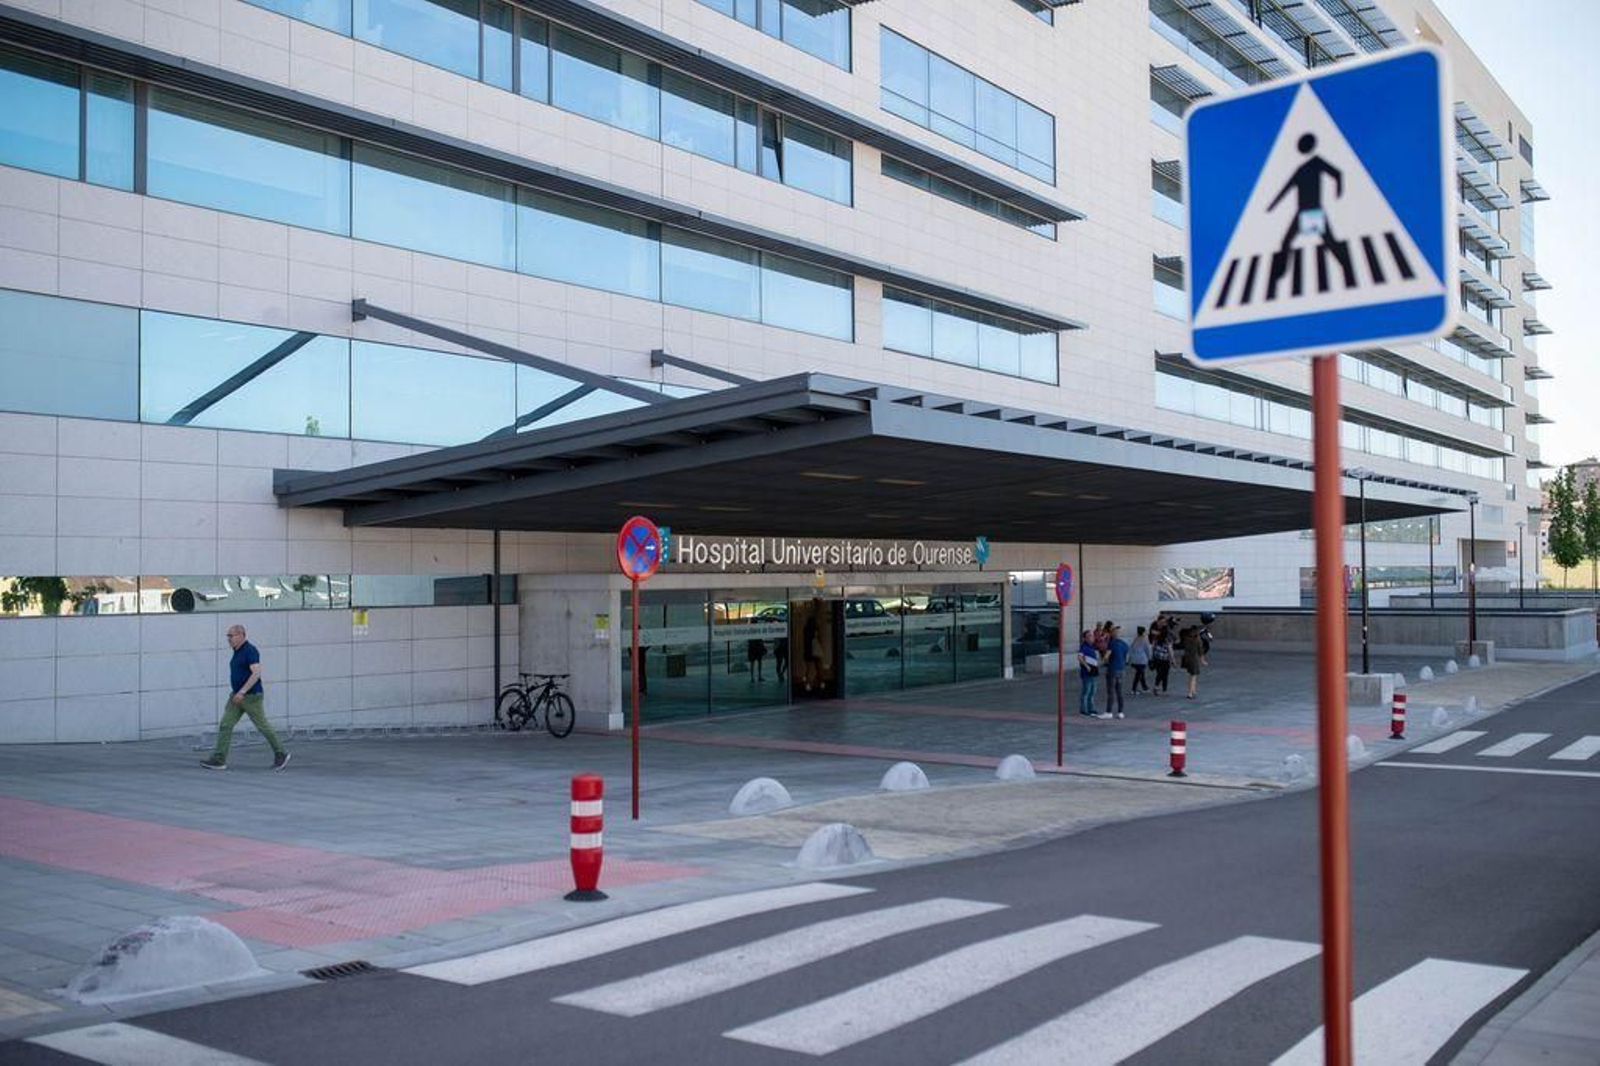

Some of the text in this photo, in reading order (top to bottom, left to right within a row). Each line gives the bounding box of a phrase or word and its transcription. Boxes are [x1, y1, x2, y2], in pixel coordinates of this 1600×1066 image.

[678, 536, 972, 570] Hospital Universitario de Ourense
